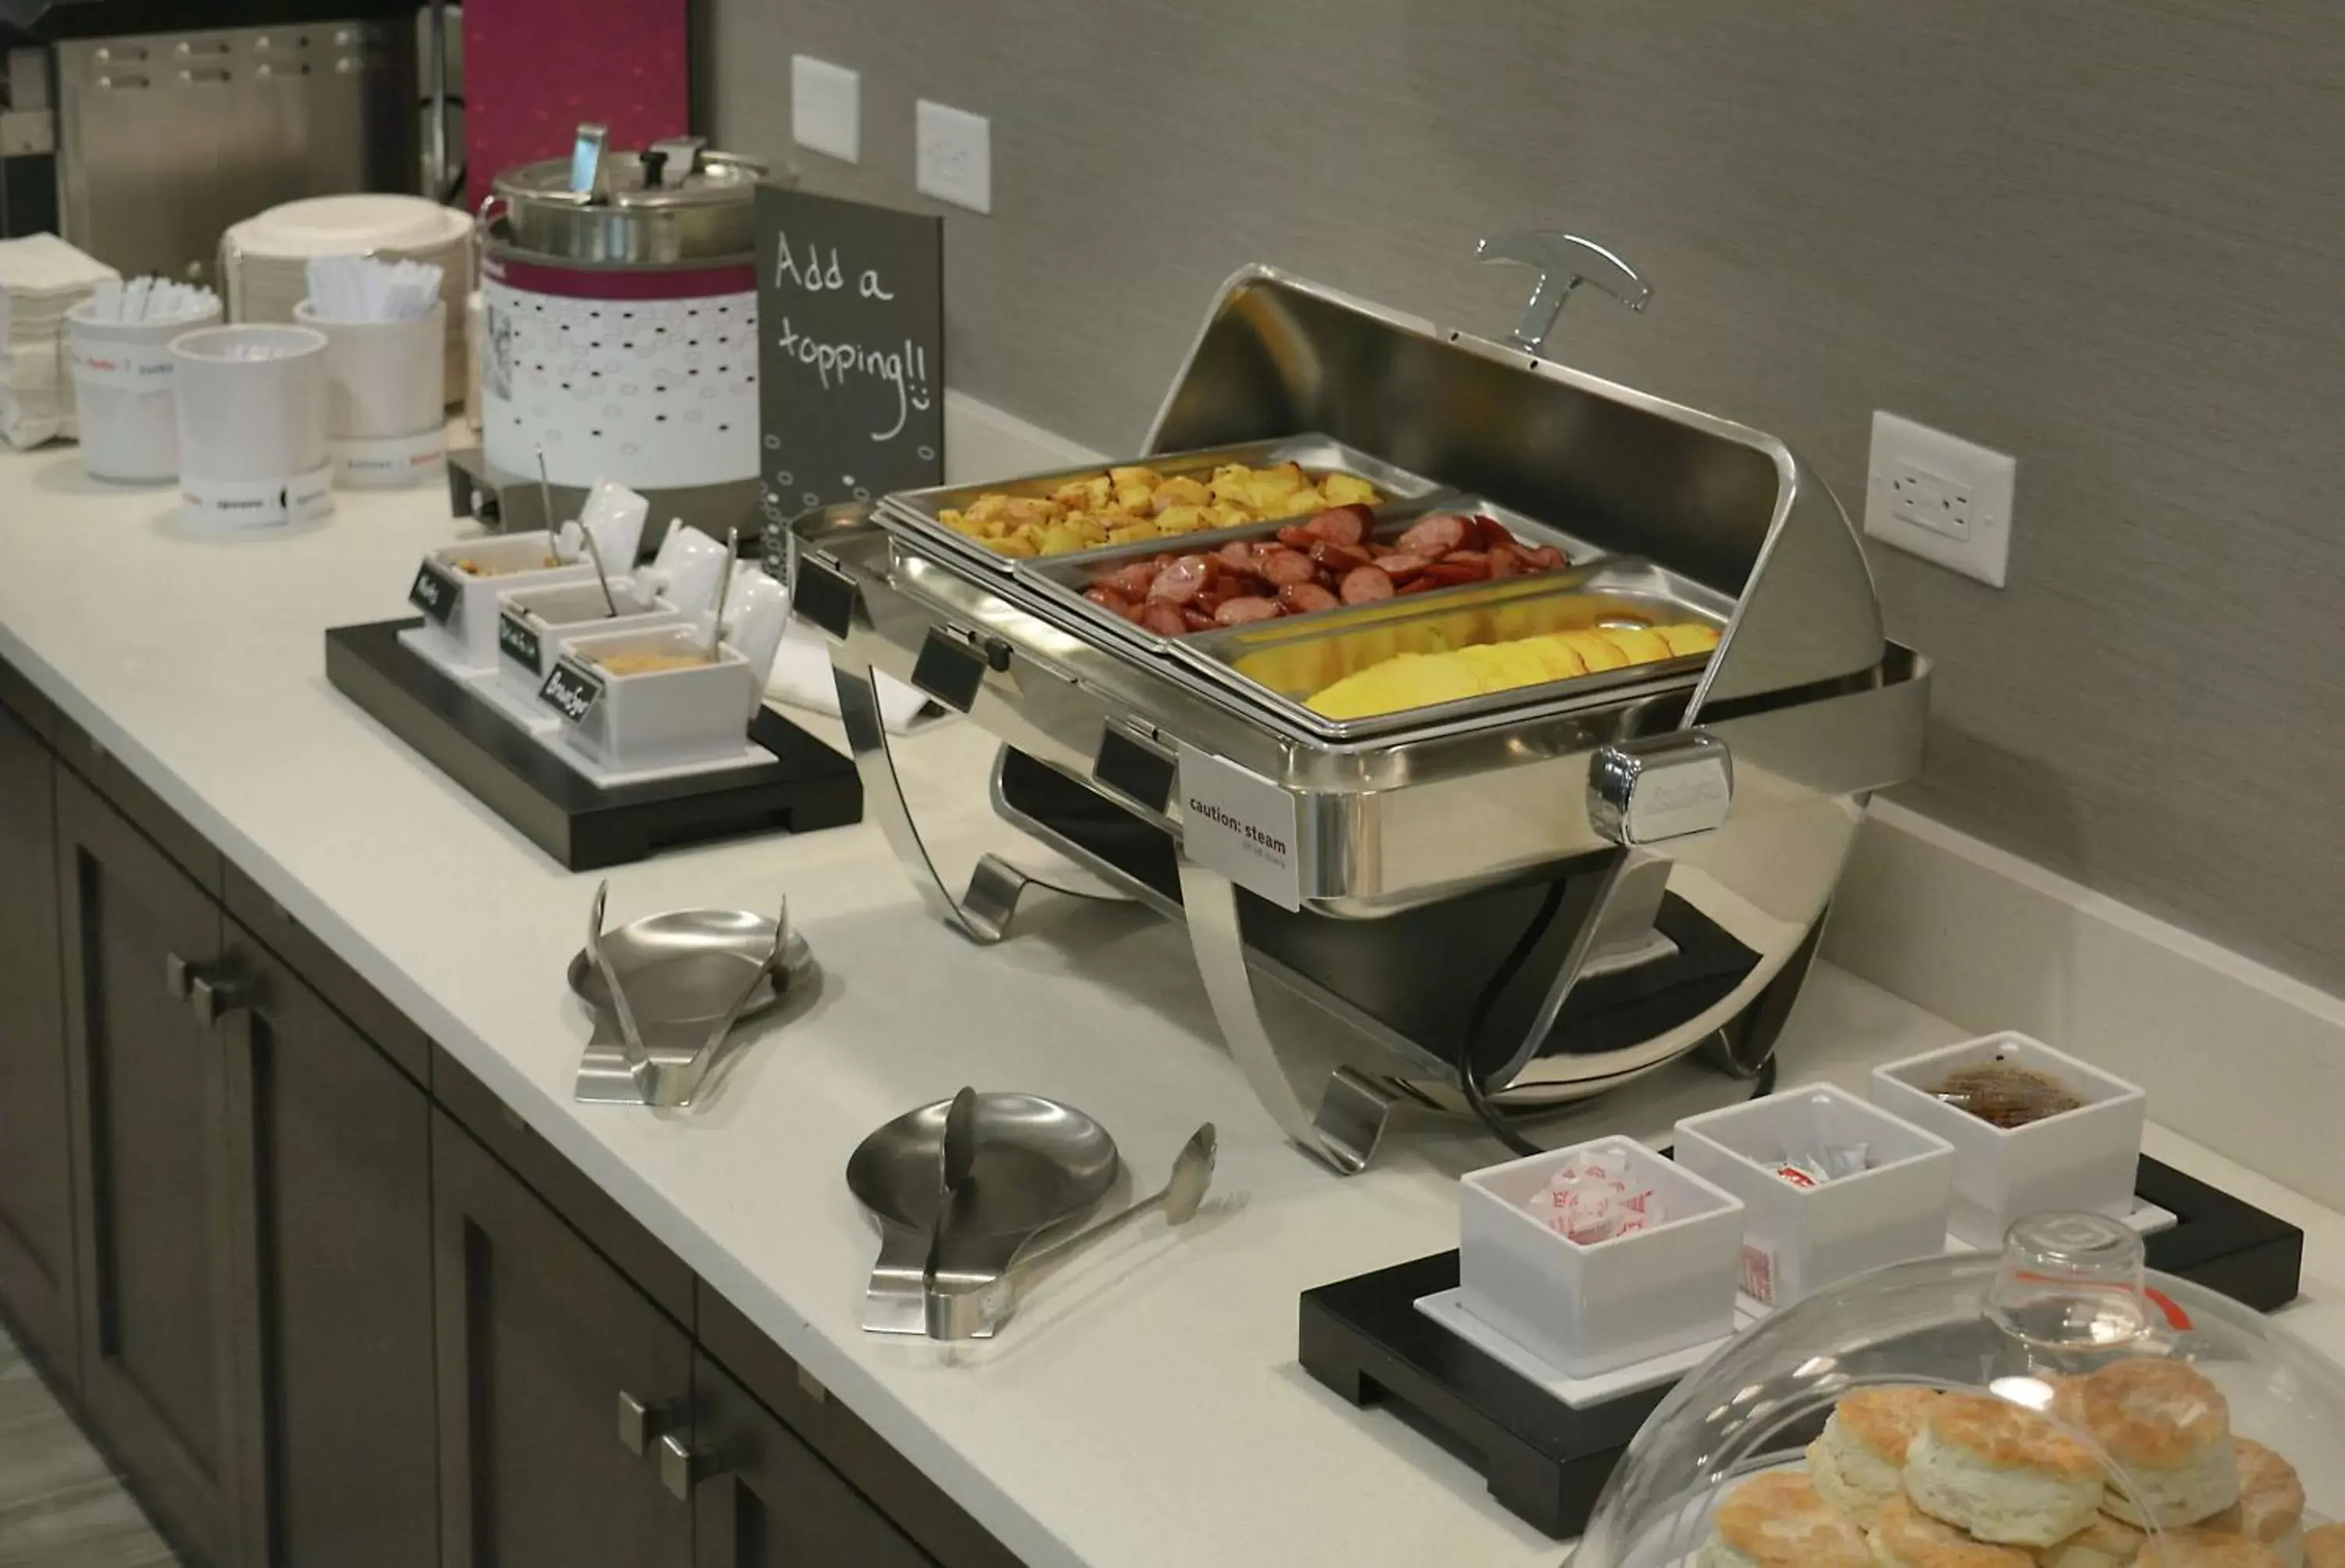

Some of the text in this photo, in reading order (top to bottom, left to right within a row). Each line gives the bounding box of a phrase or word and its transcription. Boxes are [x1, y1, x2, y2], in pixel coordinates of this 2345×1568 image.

[775, 231, 894, 300] Add a
[779, 316, 929, 442] topping!!
[1189, 796, 1242, 833] caution:
[1244, 823, 1287, 855] steam
